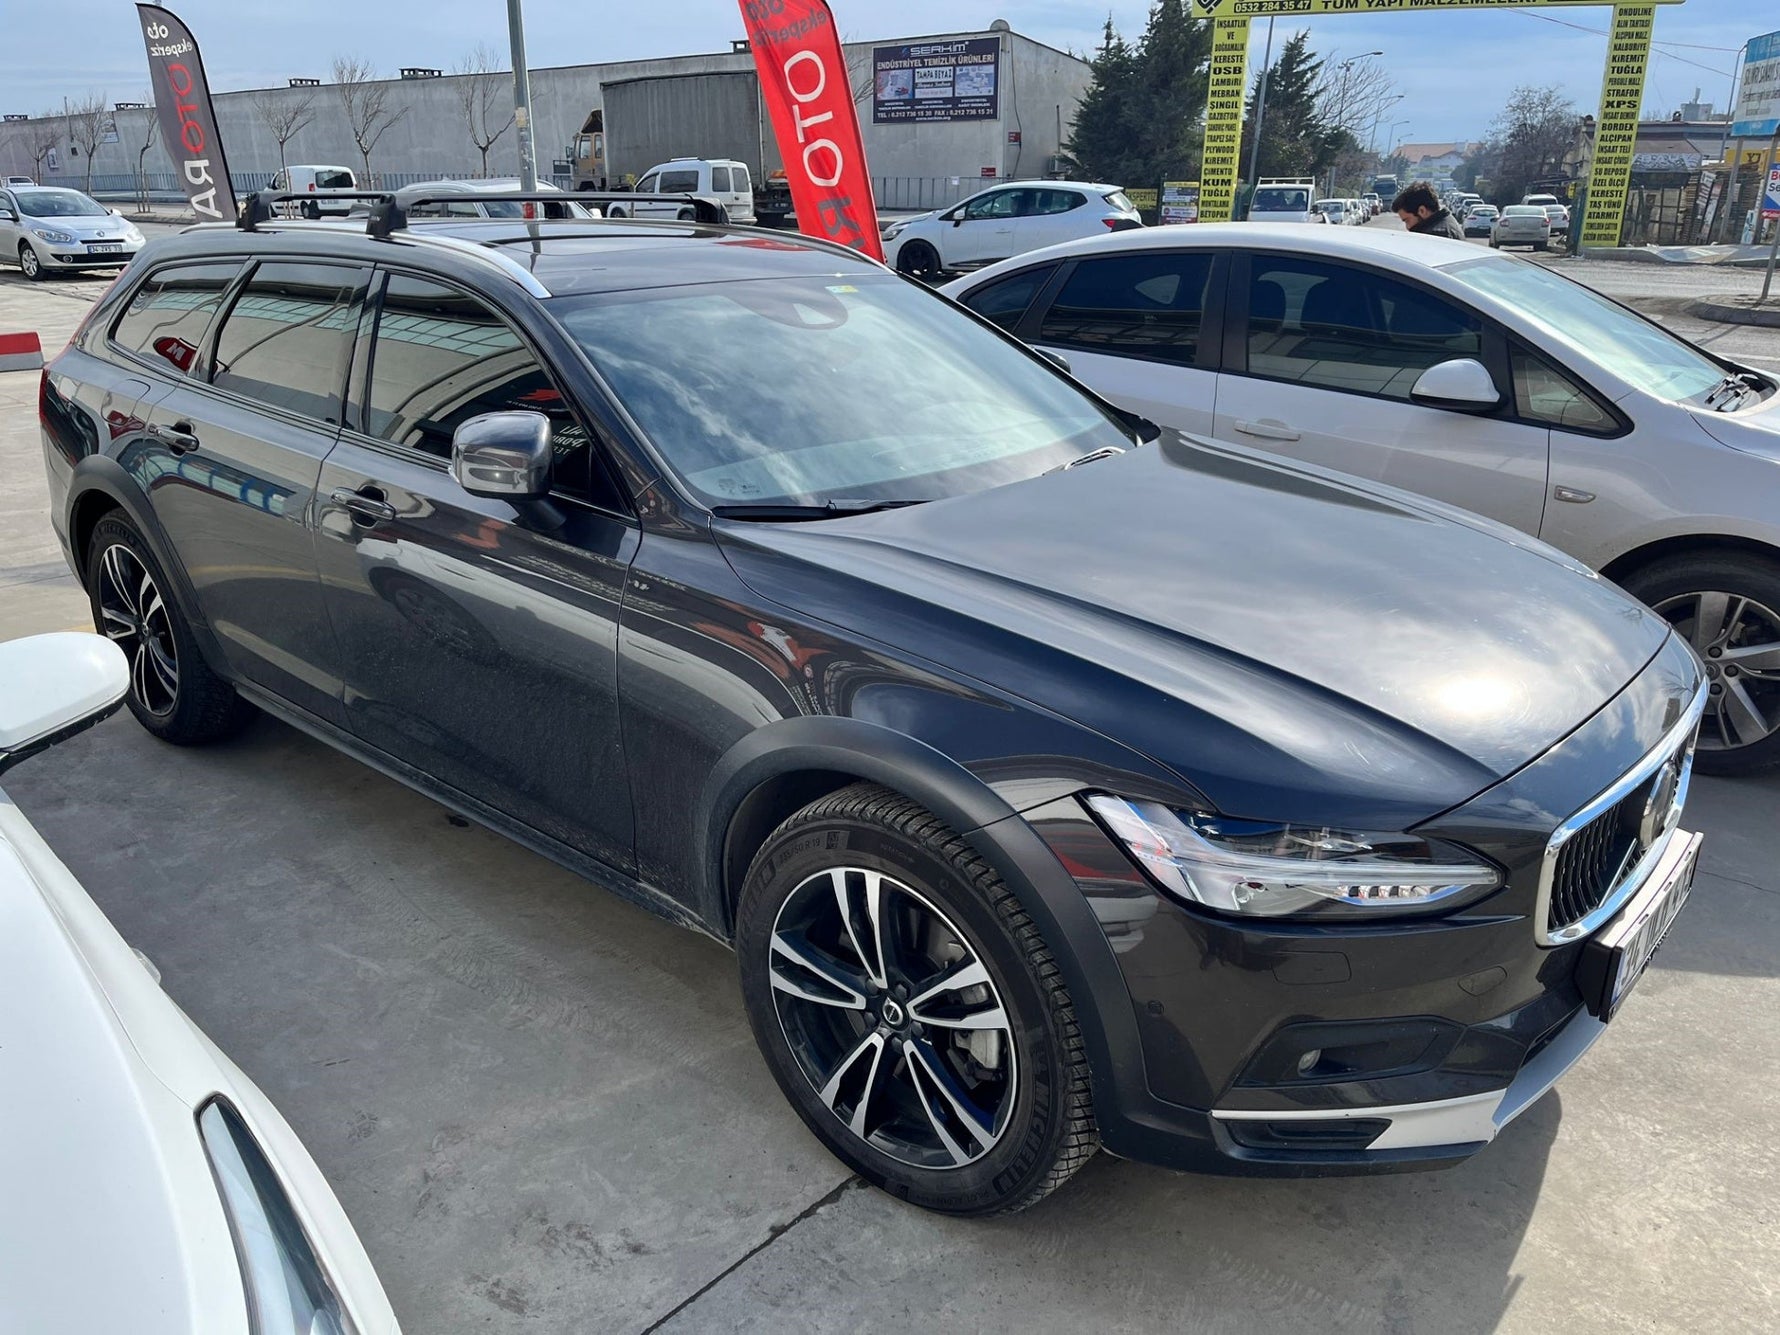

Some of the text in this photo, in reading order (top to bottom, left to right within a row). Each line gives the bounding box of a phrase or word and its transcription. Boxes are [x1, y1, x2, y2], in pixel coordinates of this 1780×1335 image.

[1235, 0, 1310, 12] 0532 284 35 47
[1227, 32, 1235, 40] VE
[877, 52, 995, 70] ENDÜSTRİYEL TEMİZLİK ÜRÜNLERİ
[1214, 54, 1244, 63] KERESTE
[1212, 66, 1242, 75] OSB
[1610, 64, 1642, 74] TUĞLA
[1210, 90, 1240, 98] MEBRAN
[1606, 88, 1640, 97] STRAFOR
[1605, 100, 1638, 108] XPS
[1602, 122, 1634, 132] BORDEX
[1206, 134, 1236, 144] TRAPEZ SAÇ
[1600, 134, 1632, 144] ALÇIPAN
[1206, 146, 1235, 154] PLYWOOD
[1594, 168, 1628, 176] SU DEPOSU
[1202, 178, 1232, 186] KUM
[1592, 178, 1626, 188] ÖZEL ÖLÇÜ
[1202, 189, 1230, 197] TUĞLA
[1590, 190, 1624, 198] KERESTE
[1590, 200, 1622, 209] TAŞ YÜNÜ
[1200, 210, 1228, 218] BETOPAN
[812, 838, 820, 846] 19
[992, 1080, 1050, 1196] MICHELIN
